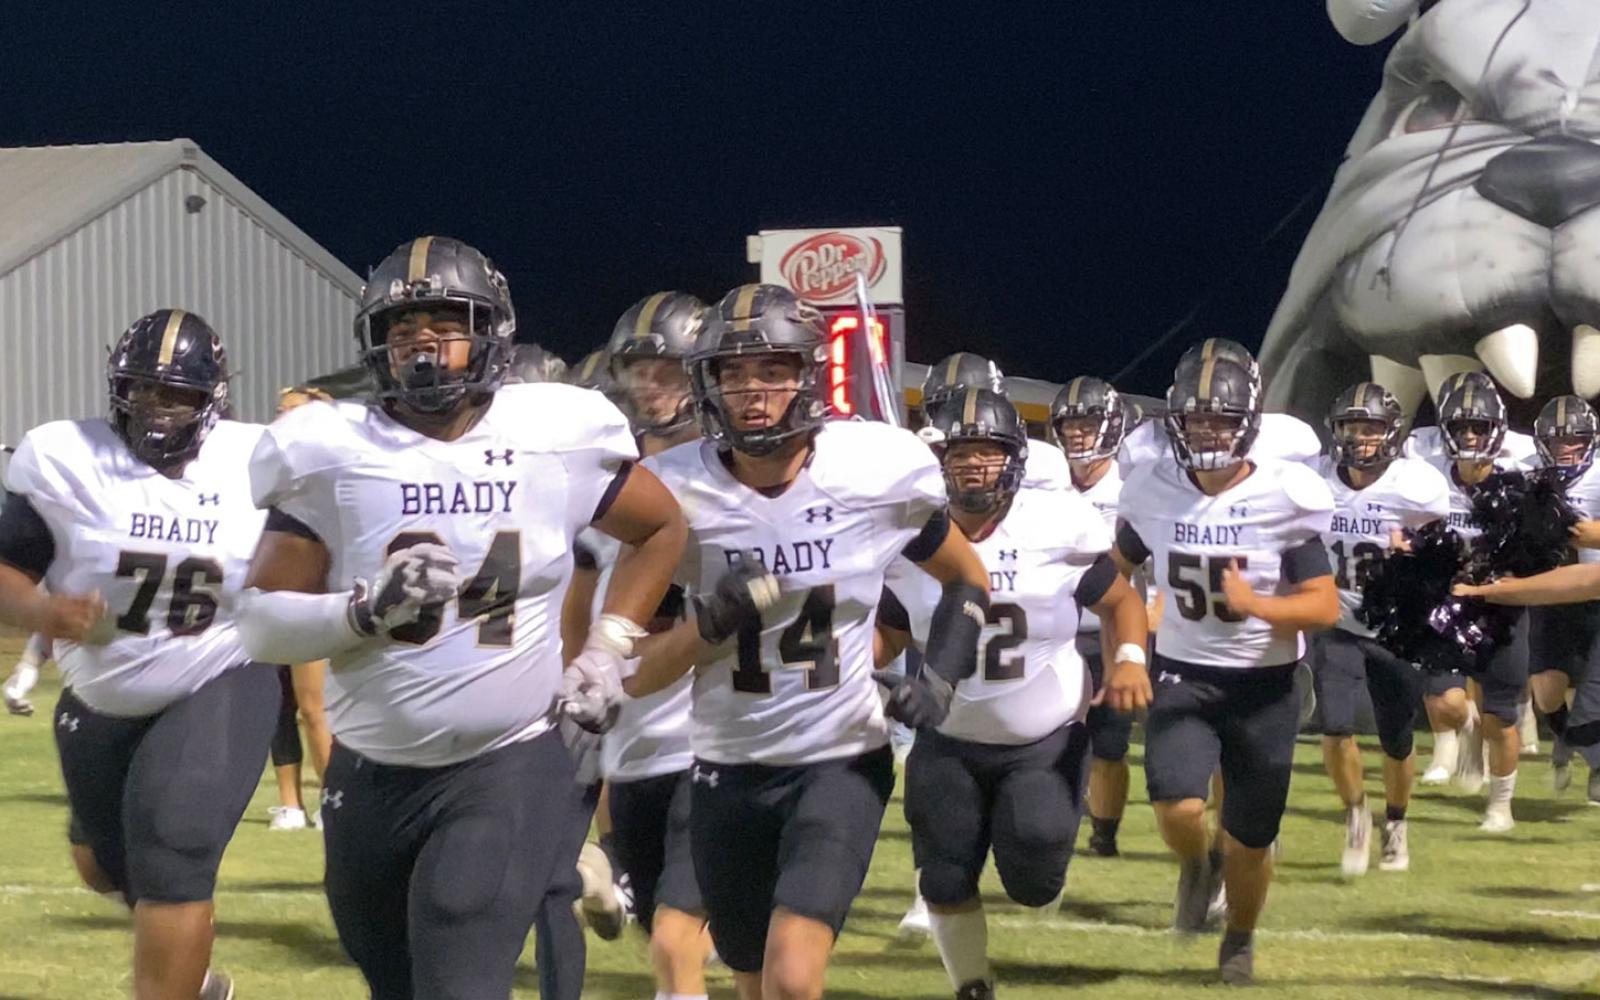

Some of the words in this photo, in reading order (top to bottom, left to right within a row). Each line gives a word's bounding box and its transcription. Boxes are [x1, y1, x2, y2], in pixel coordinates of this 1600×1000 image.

[818, 243, 847, 268] Dr
[400, 480, 517, 515] BRADY
[129, 512, 219, 544] BRADY
[1174, 522, 1243, 546] BRADY
[1330, 515, 1382, 535] BRADY
[115, 549, 224, 638] 76
[384, 529, 523, 648] 4
[1167, 551, 1249, 624] 55
[730, 582, 842, 694] 14
